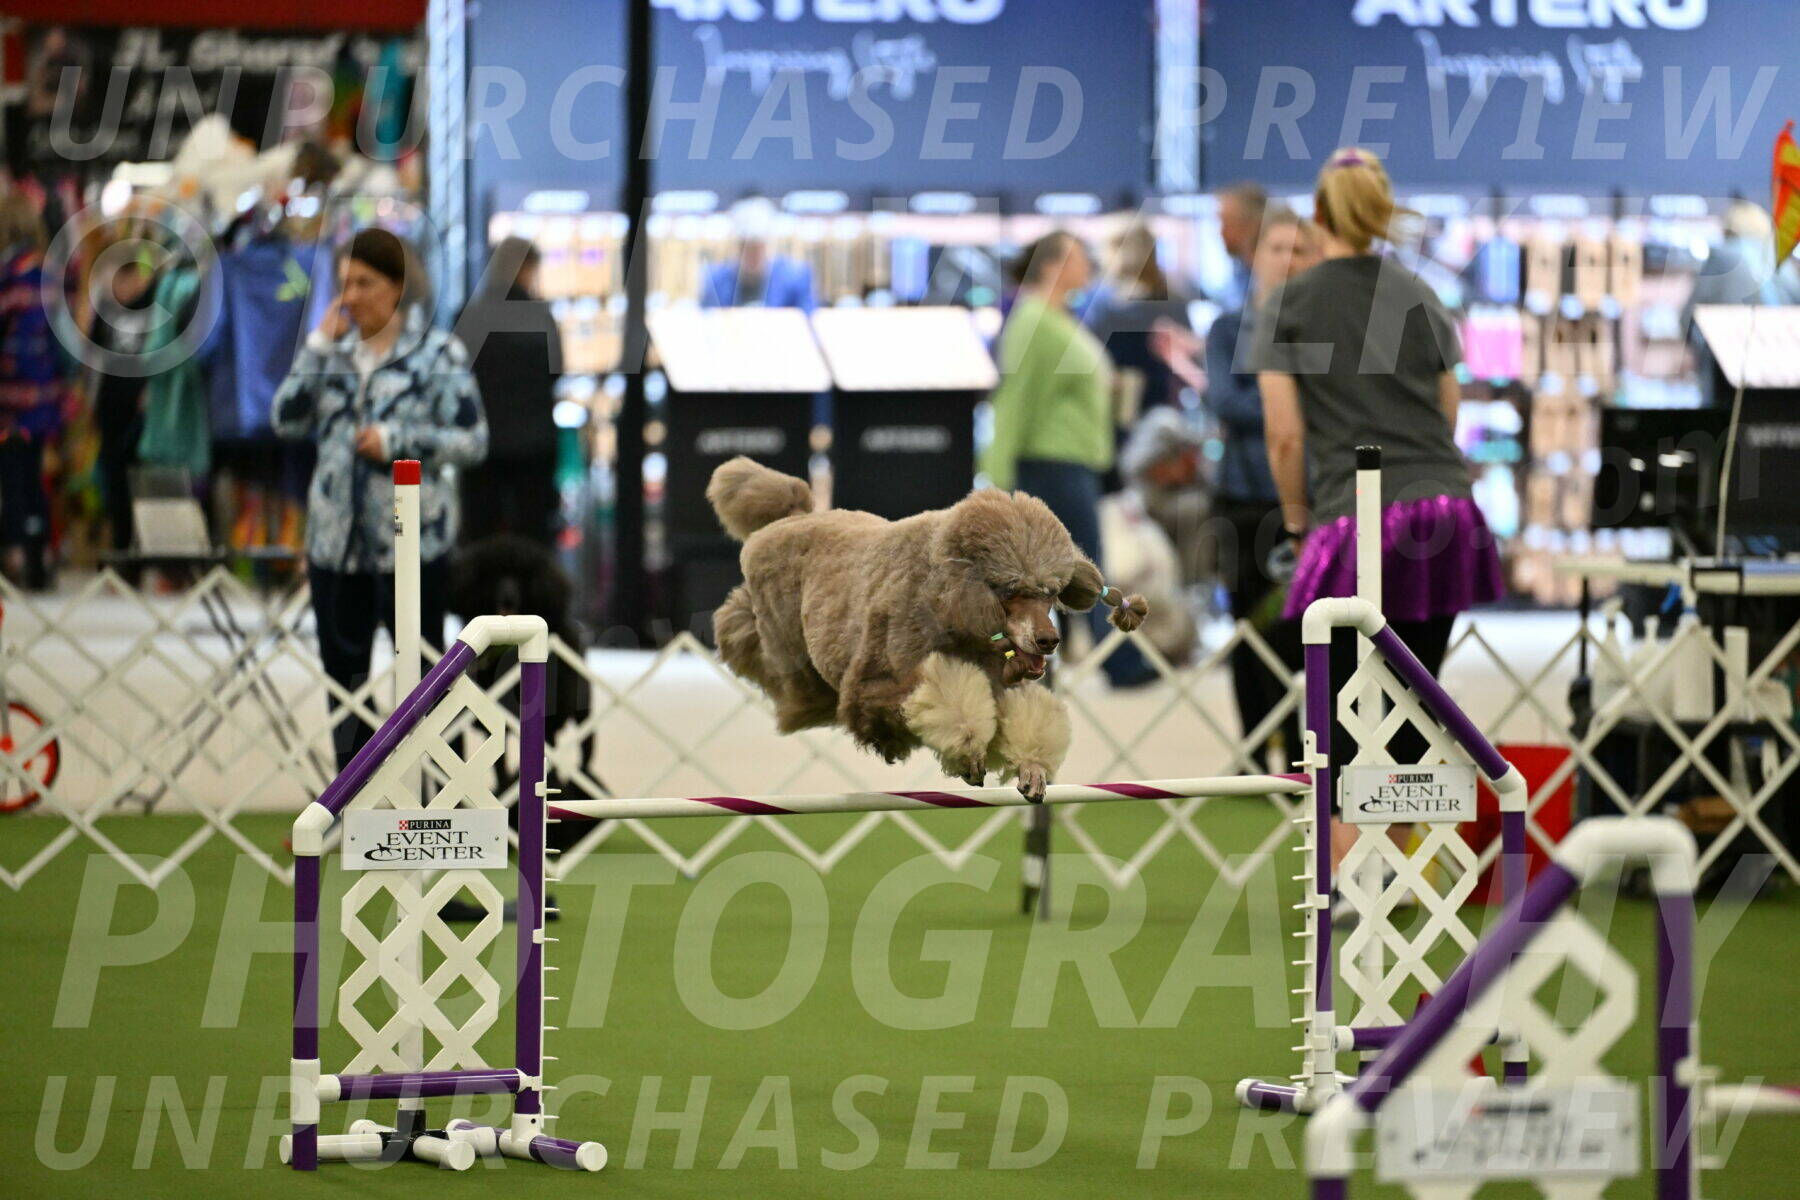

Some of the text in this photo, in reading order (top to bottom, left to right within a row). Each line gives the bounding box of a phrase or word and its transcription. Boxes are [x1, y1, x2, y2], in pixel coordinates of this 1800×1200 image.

[1396, 774, 1433, 783] PURINA
[1378, 784, 1447, 799] EVENT
[1359, 798, 1461, 814] CENTER
[408, 820, 451, 830] PURINA
[386, 831, 469, 846] EVENT
[364, 845, 486, 862] CENTER
